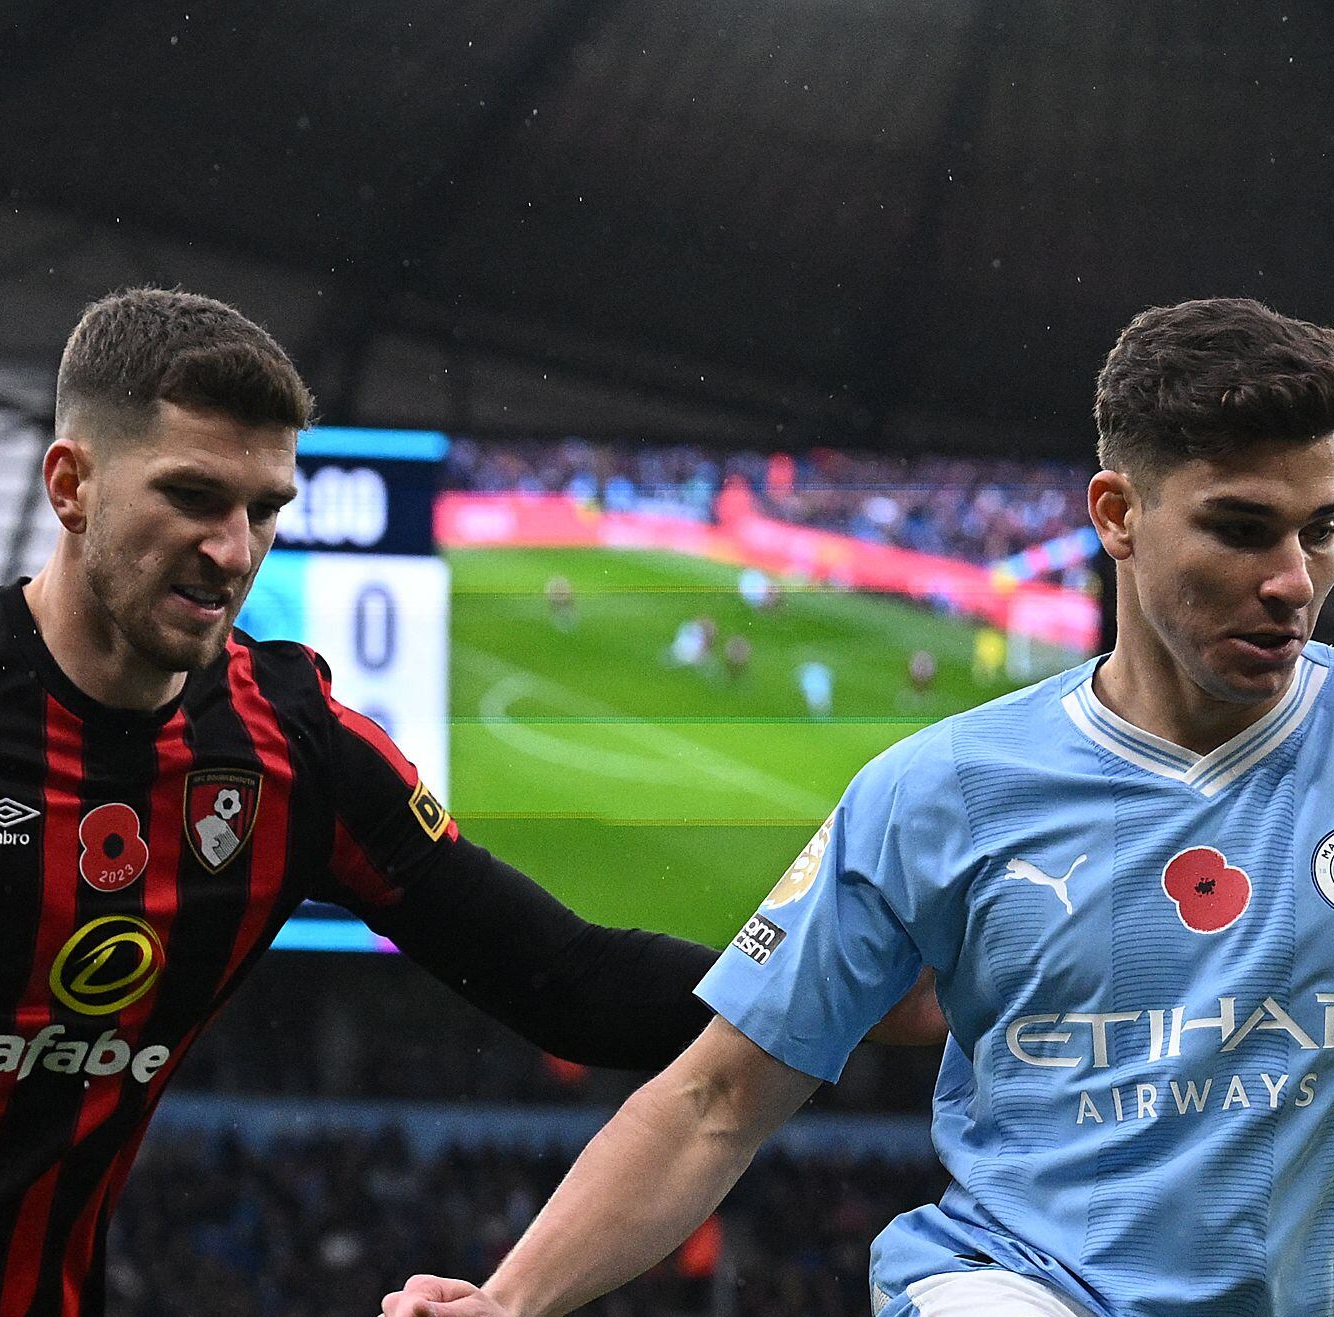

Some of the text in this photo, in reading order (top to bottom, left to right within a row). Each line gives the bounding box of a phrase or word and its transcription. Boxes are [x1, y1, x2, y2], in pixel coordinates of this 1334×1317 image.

[354, 582, 396, 673] 0
[98, 863, 135, 883] 2023
[1076, 1072, 1318, 1124] AIRWAYS
